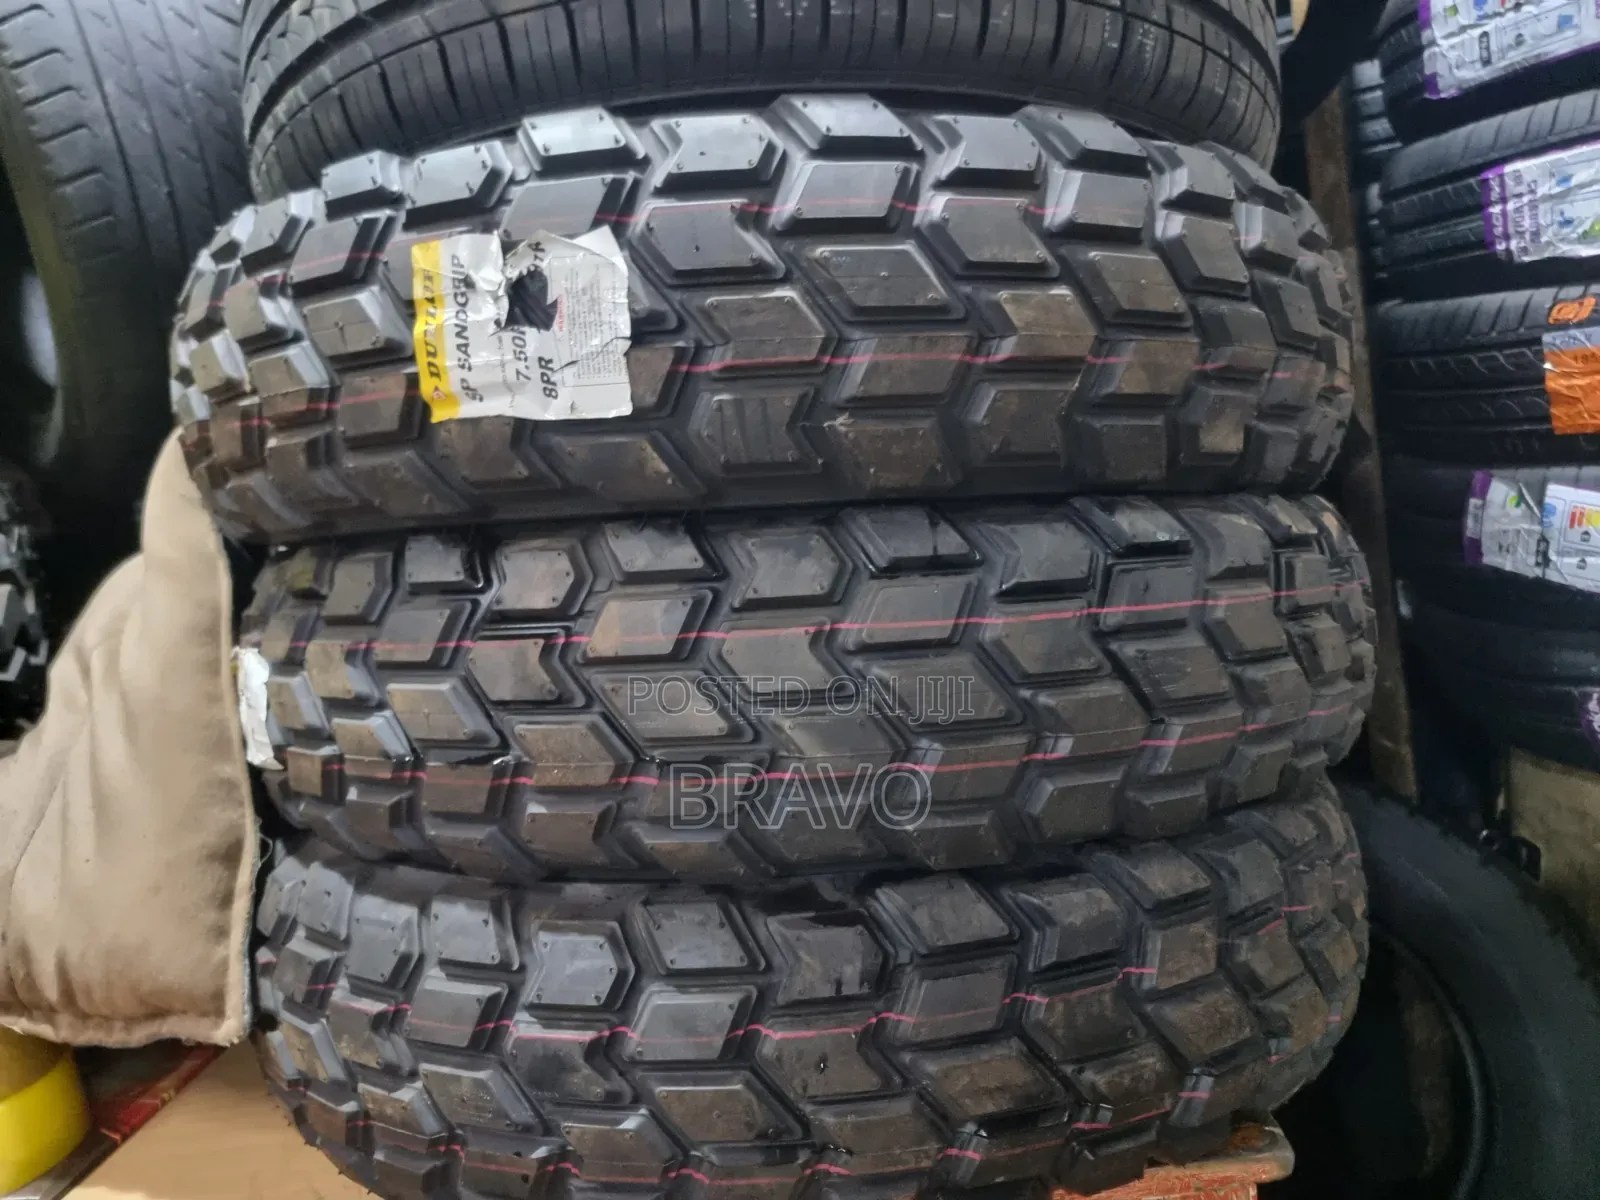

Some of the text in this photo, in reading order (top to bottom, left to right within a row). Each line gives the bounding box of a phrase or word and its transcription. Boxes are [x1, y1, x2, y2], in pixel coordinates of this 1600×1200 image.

[451, 254, 483, 402] SP SANDGRIP
[537, 356, 558, 399] 8PR
